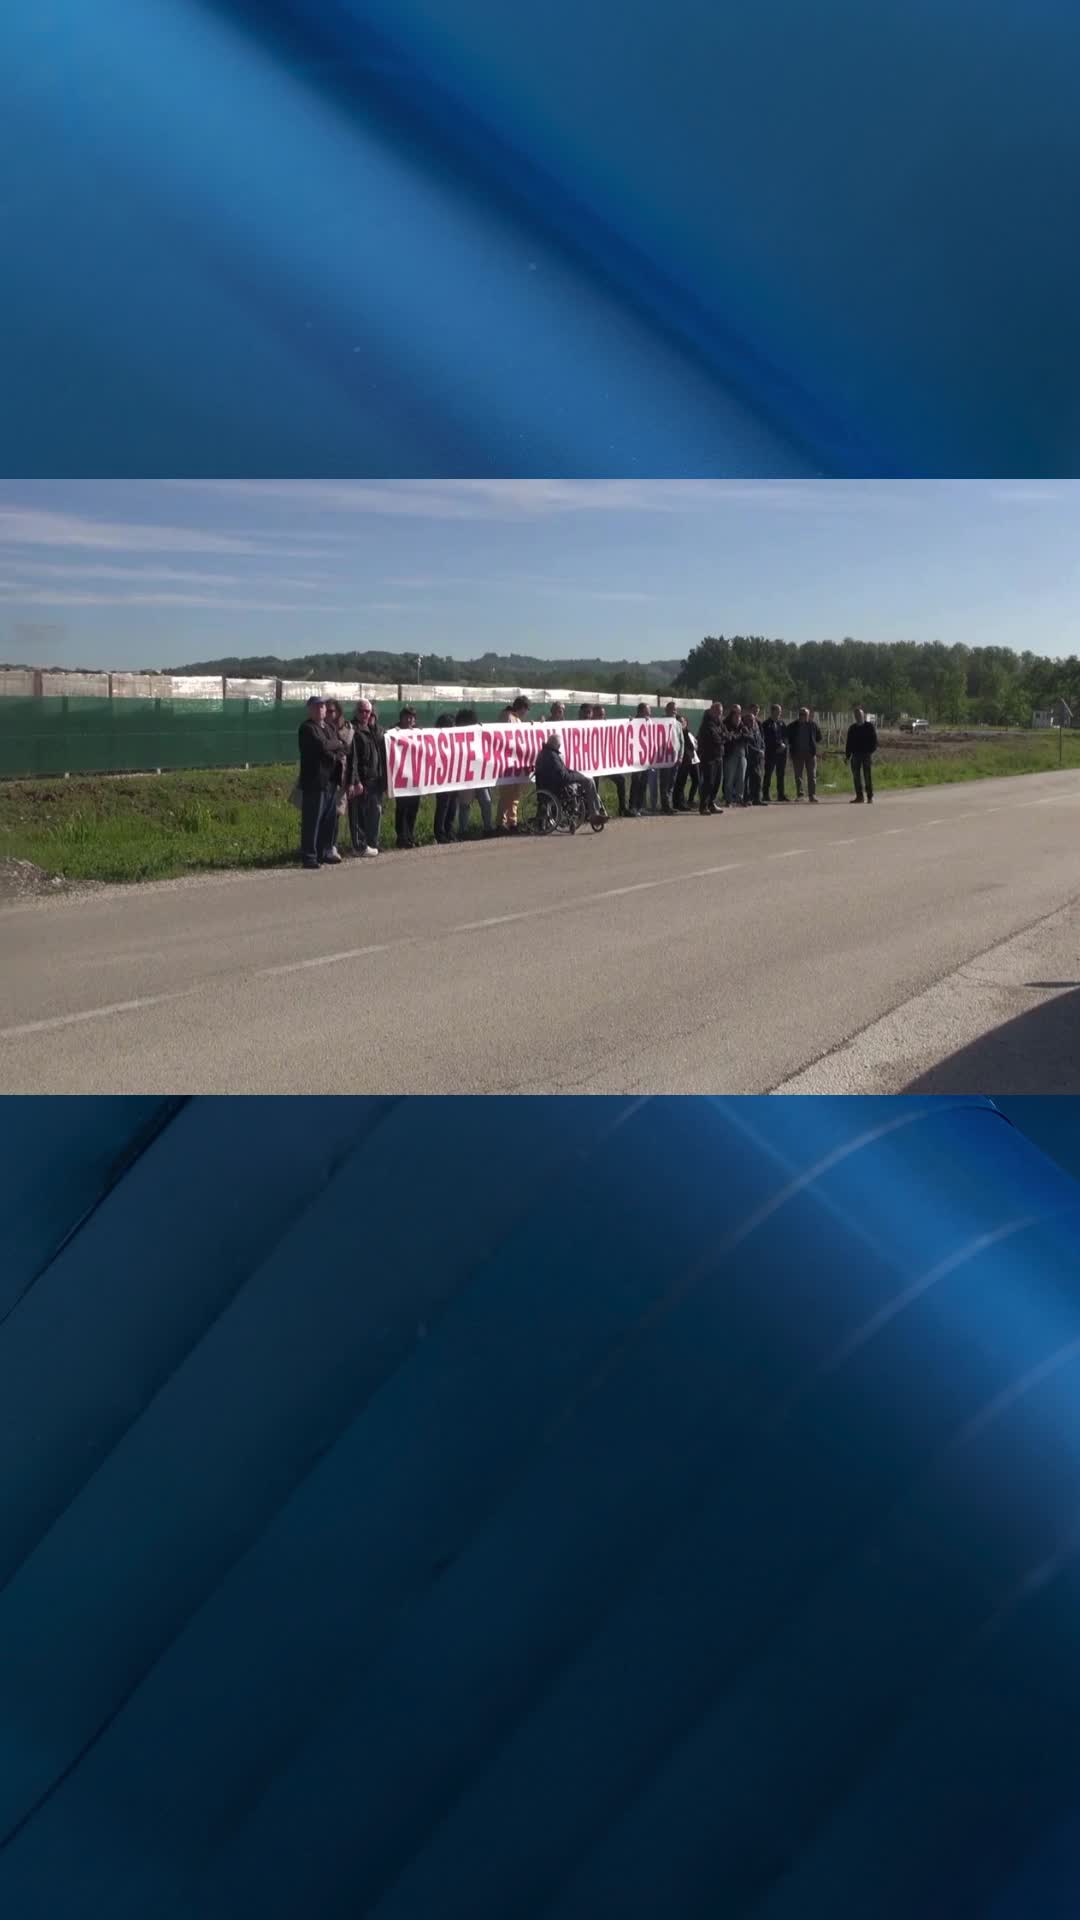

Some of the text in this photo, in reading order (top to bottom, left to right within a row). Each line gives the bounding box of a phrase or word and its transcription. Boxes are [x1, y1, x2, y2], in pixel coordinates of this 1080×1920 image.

[389, 723, 675, 788] IZVRSITE PRESU VRHOVNOG SUDA
